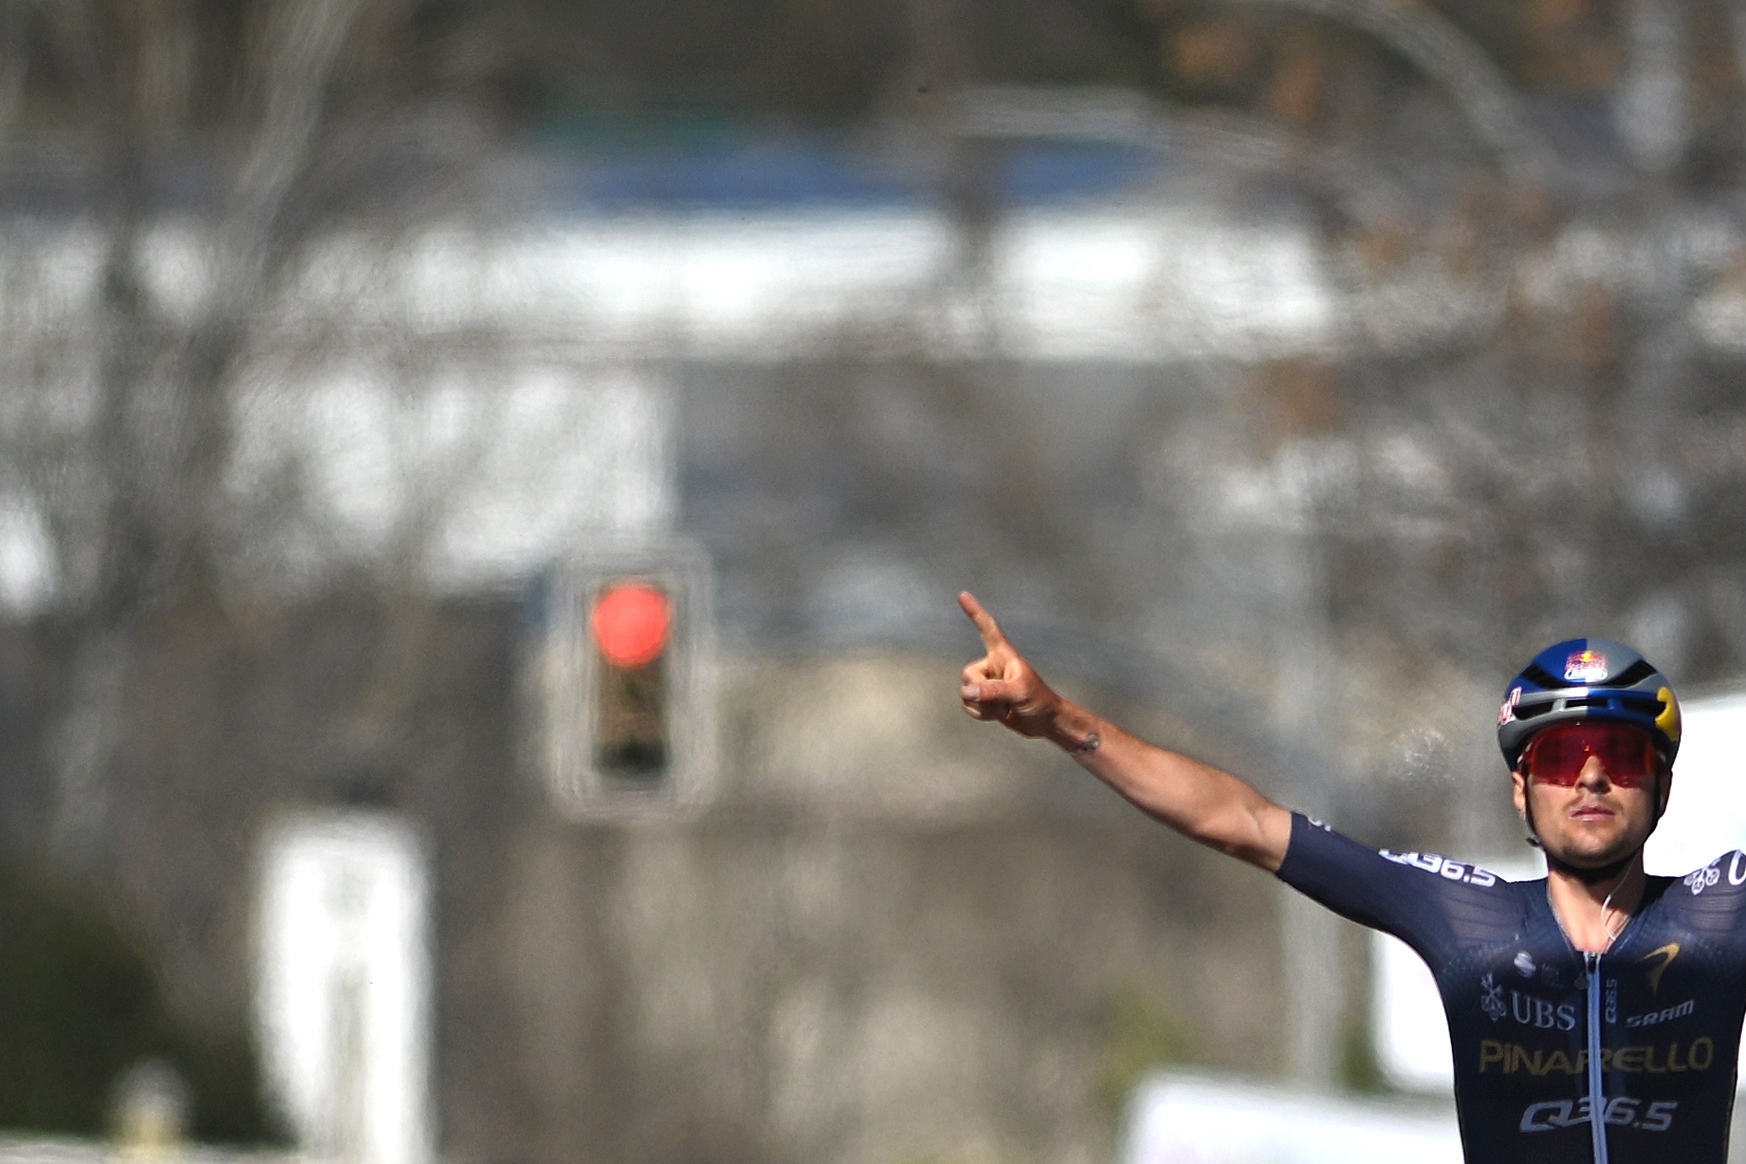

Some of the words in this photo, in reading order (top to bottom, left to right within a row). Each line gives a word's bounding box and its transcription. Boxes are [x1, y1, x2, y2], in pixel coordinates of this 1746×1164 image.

[1510, 990, 1576, 1032] UBS
[1625, 999, 1695, 1028] SRAM
[1478, 1035, 1714, 1077] PINARELLO
[1519, 1096, 1679, 1133] Q36.5
